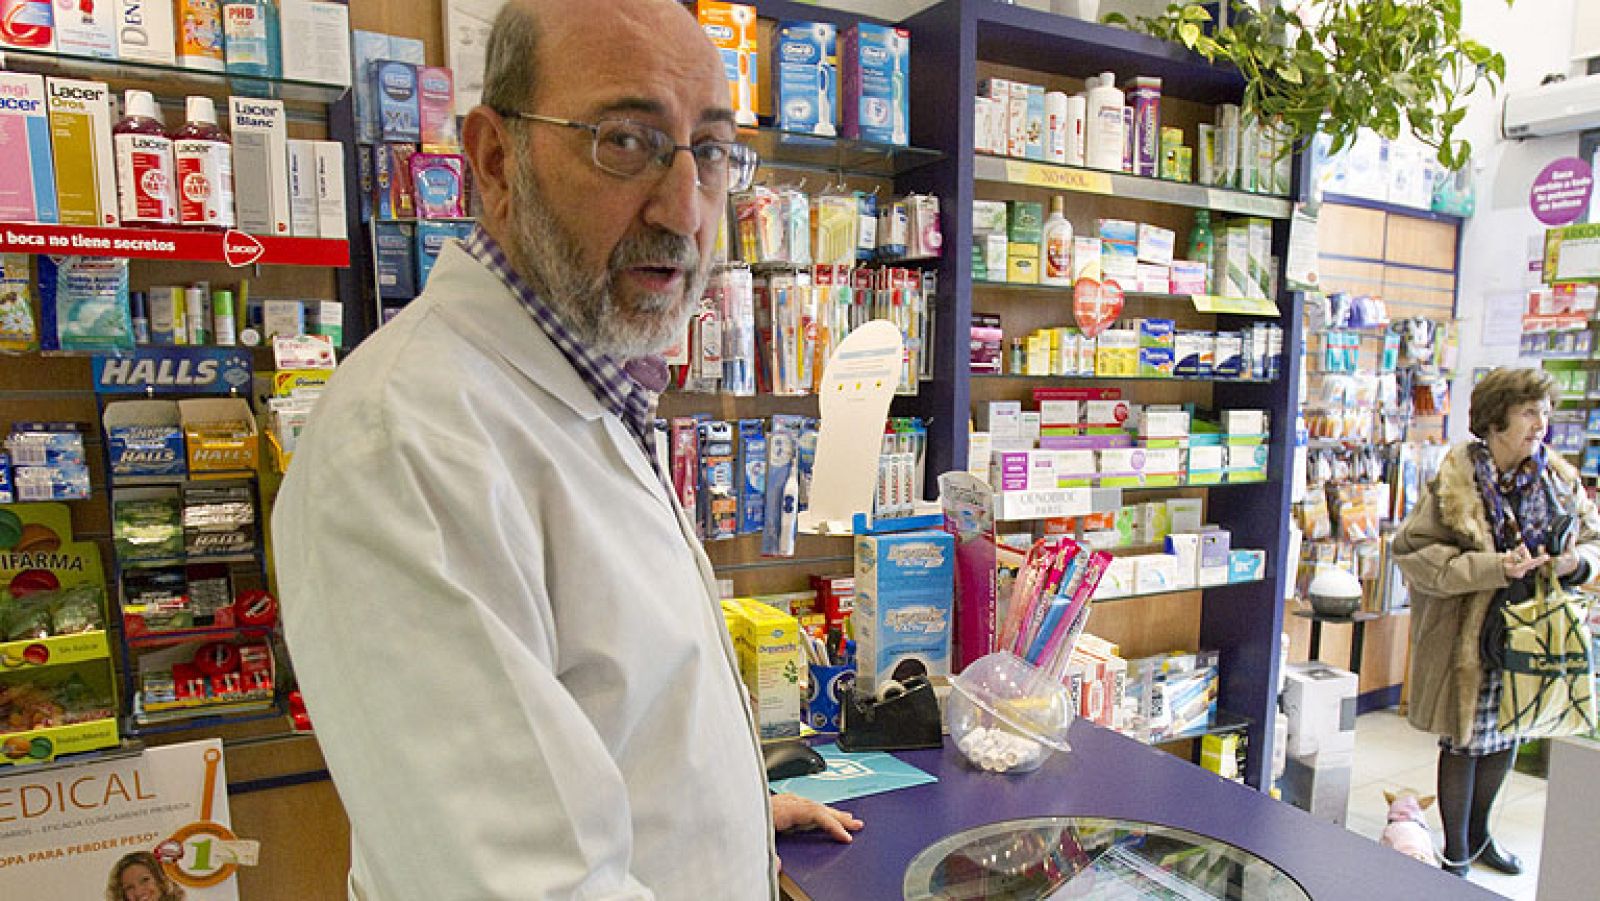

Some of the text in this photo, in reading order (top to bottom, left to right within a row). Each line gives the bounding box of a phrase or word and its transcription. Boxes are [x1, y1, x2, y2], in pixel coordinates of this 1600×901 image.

[228, 7, 254, 20] PHB
[50, 83, 105, 101] Lacer
[52, 98, 86, 109] Oros
[235, 102, 278, 118] Lacer
[236, 116, 274, 128] Blanc
[131, 137, 169, 150] Lacer
[177, 143, 212, 153] Lacer
[7, 231, 176, 252] boca no tiene secretos
[226, 244, 260, 254] Lacer
[101, 358, 218, 386] HALLS
[120, 449, 176, 465] HALLS
[193, 447, 254, 461] HALLS
[195, 534, 246, 546] HALLS
[28, 848, 64, 864] PARA
[67, 840, 118, 857] PERDER
[188, 838, 214, 870] 1
